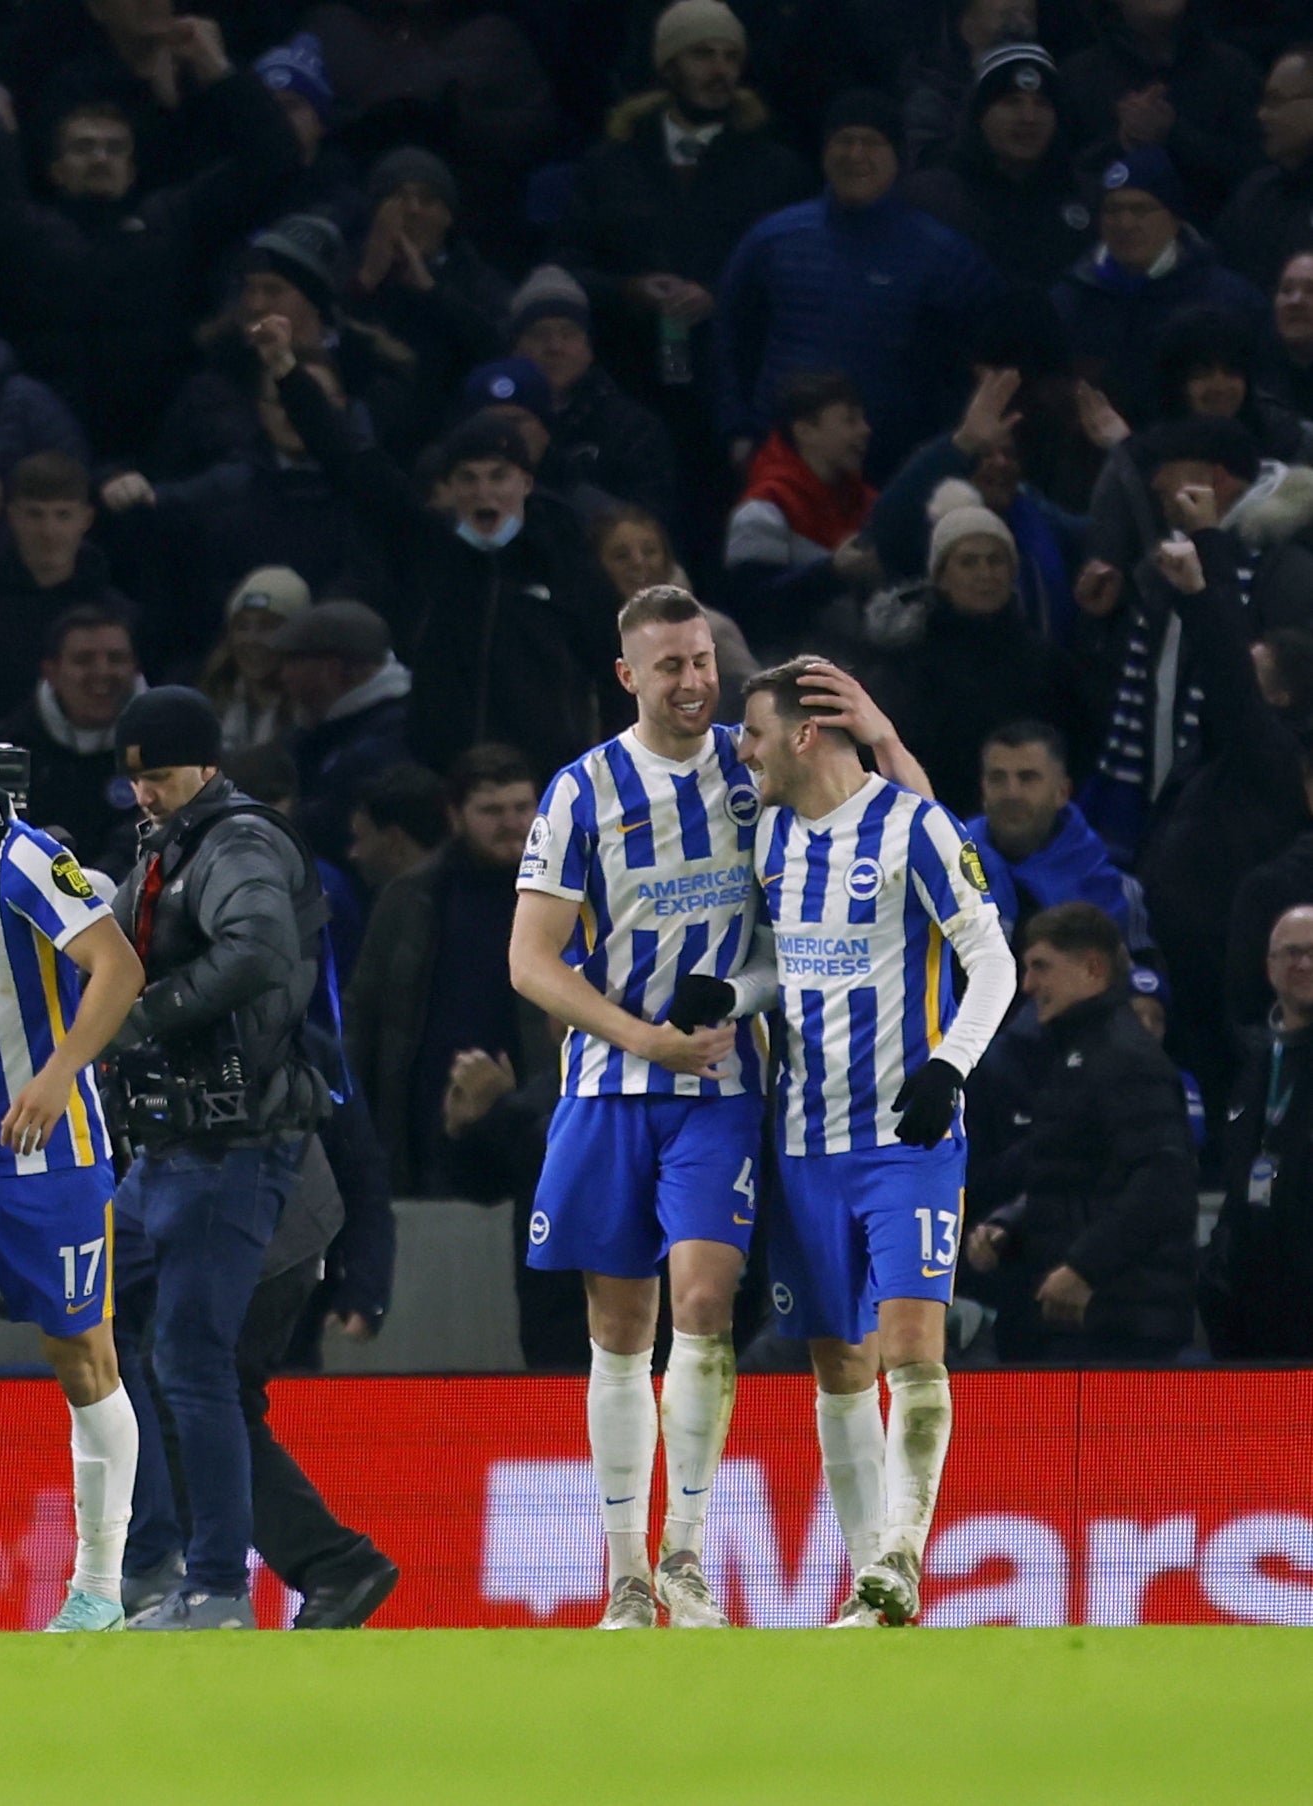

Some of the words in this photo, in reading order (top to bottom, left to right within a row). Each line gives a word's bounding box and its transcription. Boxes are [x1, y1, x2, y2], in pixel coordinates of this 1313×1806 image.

[784, 957, 872, 976] EXPRESS
[732, 1156, 755, 1210] 4
[914, 1207, 957, 1266] 13
[58, 1236, 105, 1299] 17
